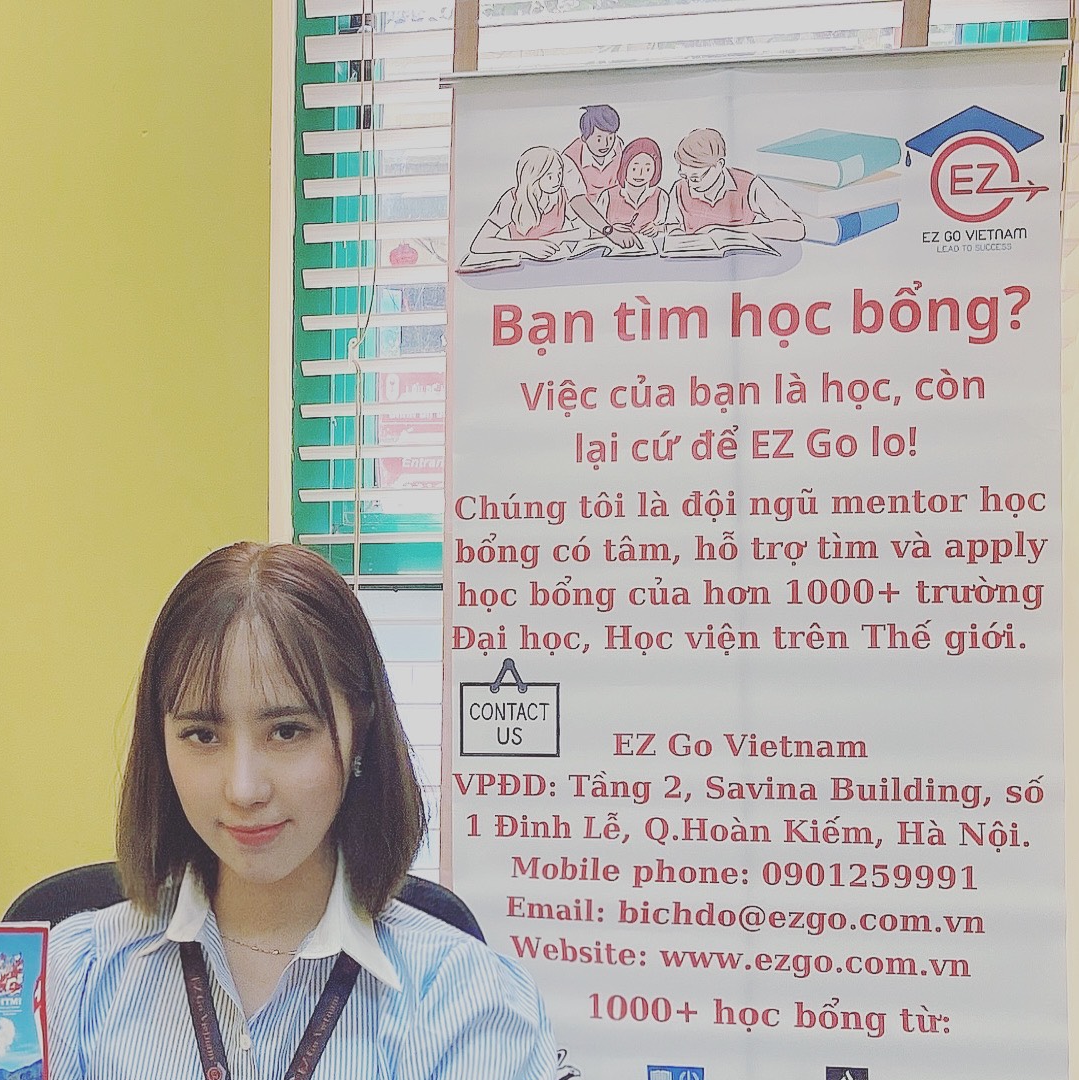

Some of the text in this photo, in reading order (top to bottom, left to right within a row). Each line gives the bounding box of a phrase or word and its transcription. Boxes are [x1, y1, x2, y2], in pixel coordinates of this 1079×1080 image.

[951, 163, 1014, 195] EZ
[923, 232, 939, 243] EZ
[945, 230, 961, 242] GO
[937, 244, 959, 253] LEAD
[975, 243, 1012, 251] SUCCESS
[491, 280, 1032, 356] Bạn tìm học bổng?
[521, 369, 985, 418] Việc của bạn là học, còn
[576, 425, 918, 469] lại cứ để EZ Go lo!
[454, 486, 1047, 524] Chúng tôi là đội ngũ mentor học
[455, 530, 1049, 570] bổng có tâm, hỗ trợ tìm và apply
[457, 576, 1045, 613] học bổng của hơn 1000+ trường
[451, 619, 1028, 656] Đại học, Học viện trên Thế giới.
[469, 702, 549, 722] CONTACT
[497, 727, 523, 746] US
[613, 732, 868, 758] EZ Go Vietnam
[452, 769, 1045, 809] VPĐD: Tầng 2, Savina Building, số
[466, 811, 1031, 854] 1 Đinh Lễ, Q.Hoàn Kiếm, Hà Nội.
[511, 856, 980, 891] Mobile phone: 0901259991
[505, 896, 986, 935] Email: bichdo@ezgo.com.vn
[510, 935, 972, 978] Website: www.ezgo.com.vn
[588, 993, 951, 1037] 1000+ học bổng từ:
